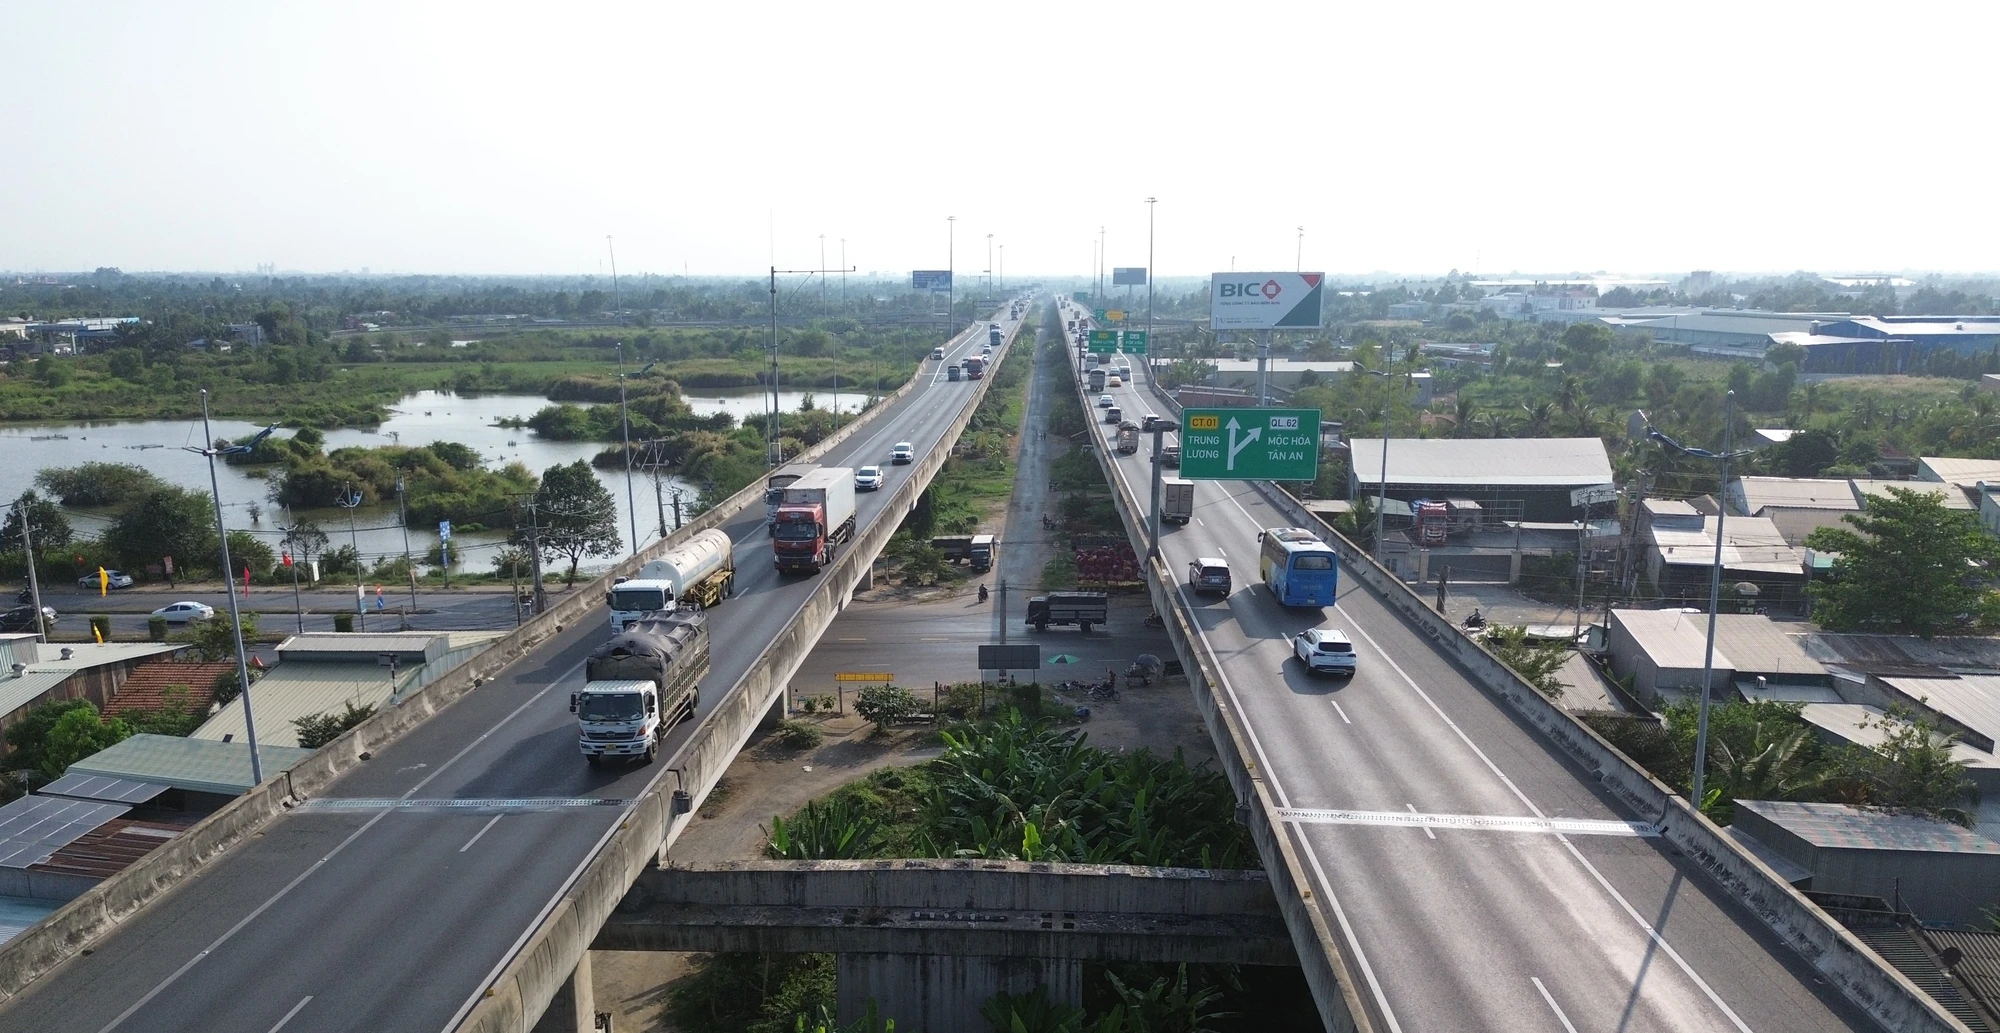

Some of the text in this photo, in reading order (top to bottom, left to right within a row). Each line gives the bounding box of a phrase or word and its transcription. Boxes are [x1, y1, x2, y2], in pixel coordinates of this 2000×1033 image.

[1220, 283, 1260, 297] BIC
[1192, 418, 1216, 427] CT.01
[1271, 419, 1297, 427] QL.62
[1188, 435, 1219, 445] TRUNG
[1268, 434, 1311, 447] MỘC HÓA
[1186, 449, 1219, 458] LƯƠNG
[1268, 449, 1303, 460] TÂN AN
